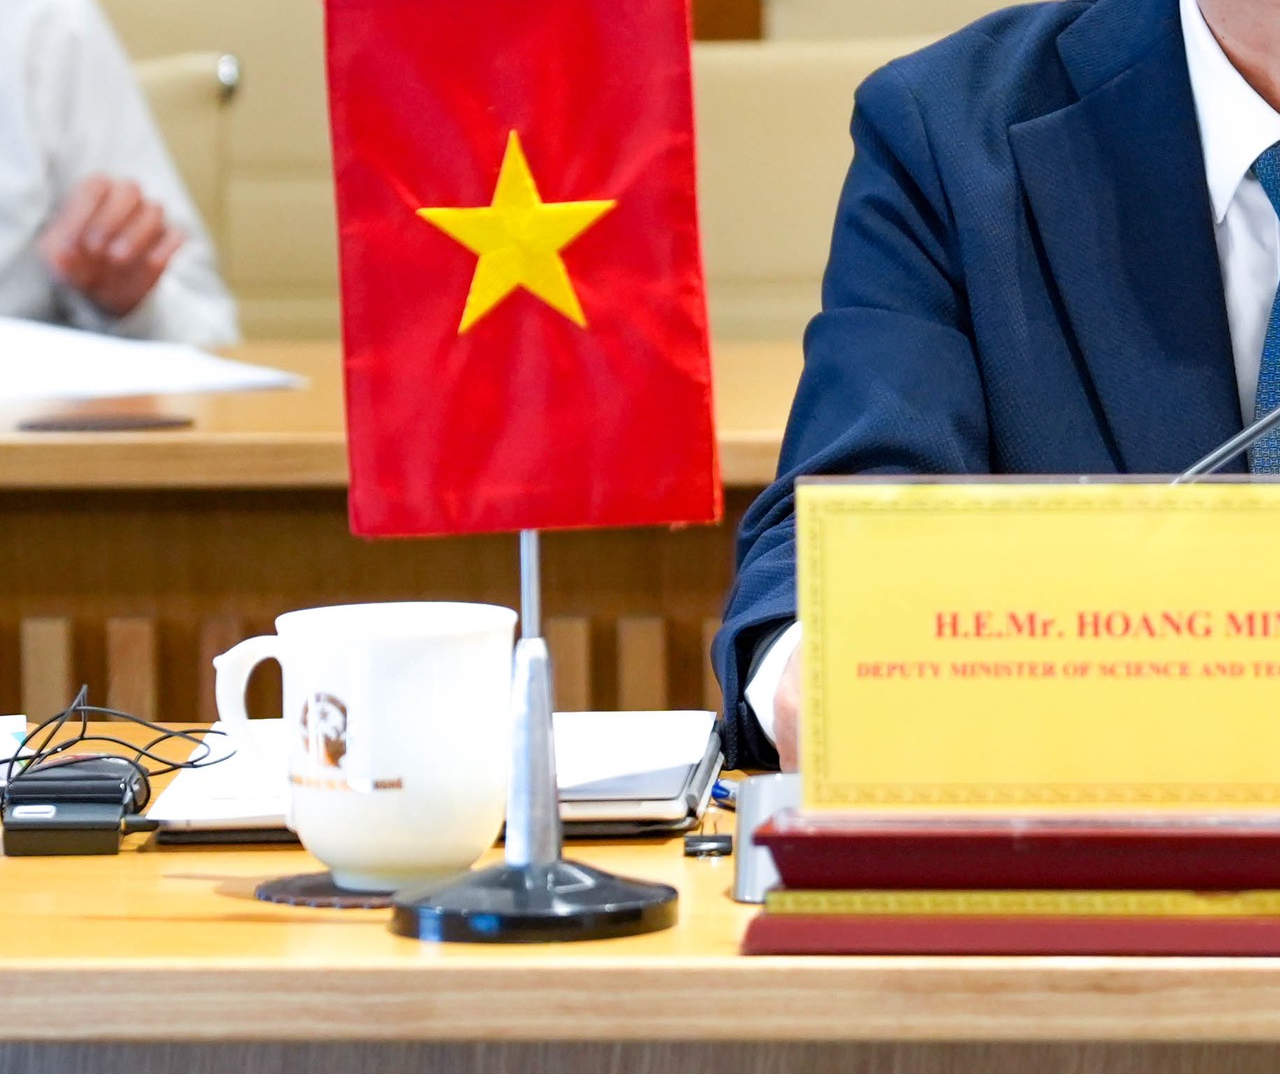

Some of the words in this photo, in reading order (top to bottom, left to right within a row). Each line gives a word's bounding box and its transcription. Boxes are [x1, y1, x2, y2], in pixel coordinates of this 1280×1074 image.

[934, 610, 1065, 639] H.E.Mr.
[1076, 610, 1213, 639] HOANG
[856, 661, 942, 678] DEPUTY
[950, 661, 1056, 678] MINISTER
[1062, 661, 1092, 678] OF
[1098, 661, 1191, 678] SCIENCE
[1200, 661, 1246, 678] AND
